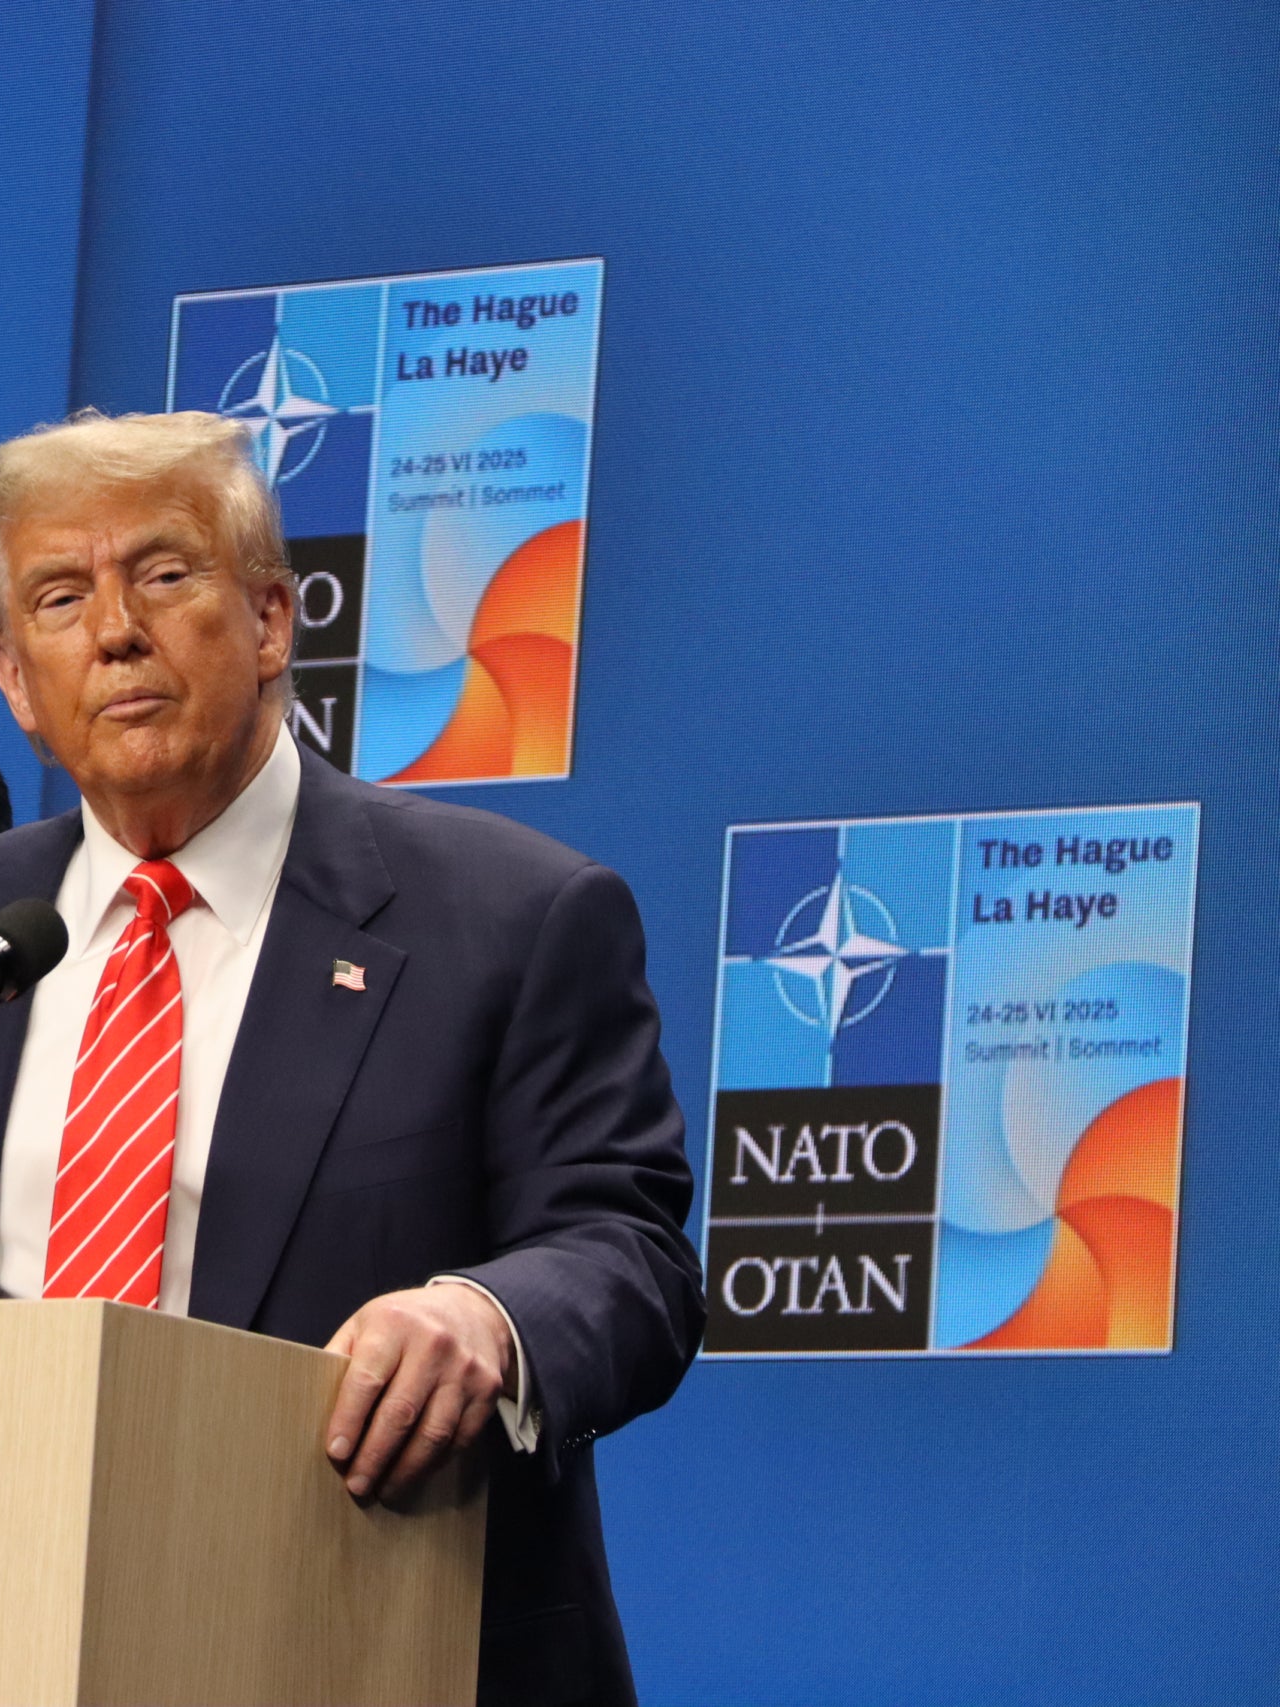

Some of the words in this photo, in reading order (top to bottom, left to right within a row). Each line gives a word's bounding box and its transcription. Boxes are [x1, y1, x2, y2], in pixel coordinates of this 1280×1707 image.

[403, 299, 461, 330] The
[473, 291, 579, 330] Hague
[397, 352, 433, 381] La
[445, 346, 528, 383] Haye
[390, 454, 446, 477] 24-25
[450, 452, 470, 473] VI
[477, 448, 527, 471] 2025
[389, 489, 465, 512] Summit
[482, 481, 565, 505] Sommet
[977, 839, 1042, 869] The
[1056, 836, 1174, 873] Hague
[973, 893, 1013, 924] La
[1027, 890, 1118, 930] Haye
[967, 1002, 1028, 1025] 24-25
[1034, 1001, 1056, 1022] VI
[1064, 998, 1119, 1021] 2025
[966, 1041, 1049, 1062] Summit
[1069, 1037, 1162, 1059] Sommet
[730, 1120, 917, 1184] NATO
[723, 1253, 913, 1315] OTAN
